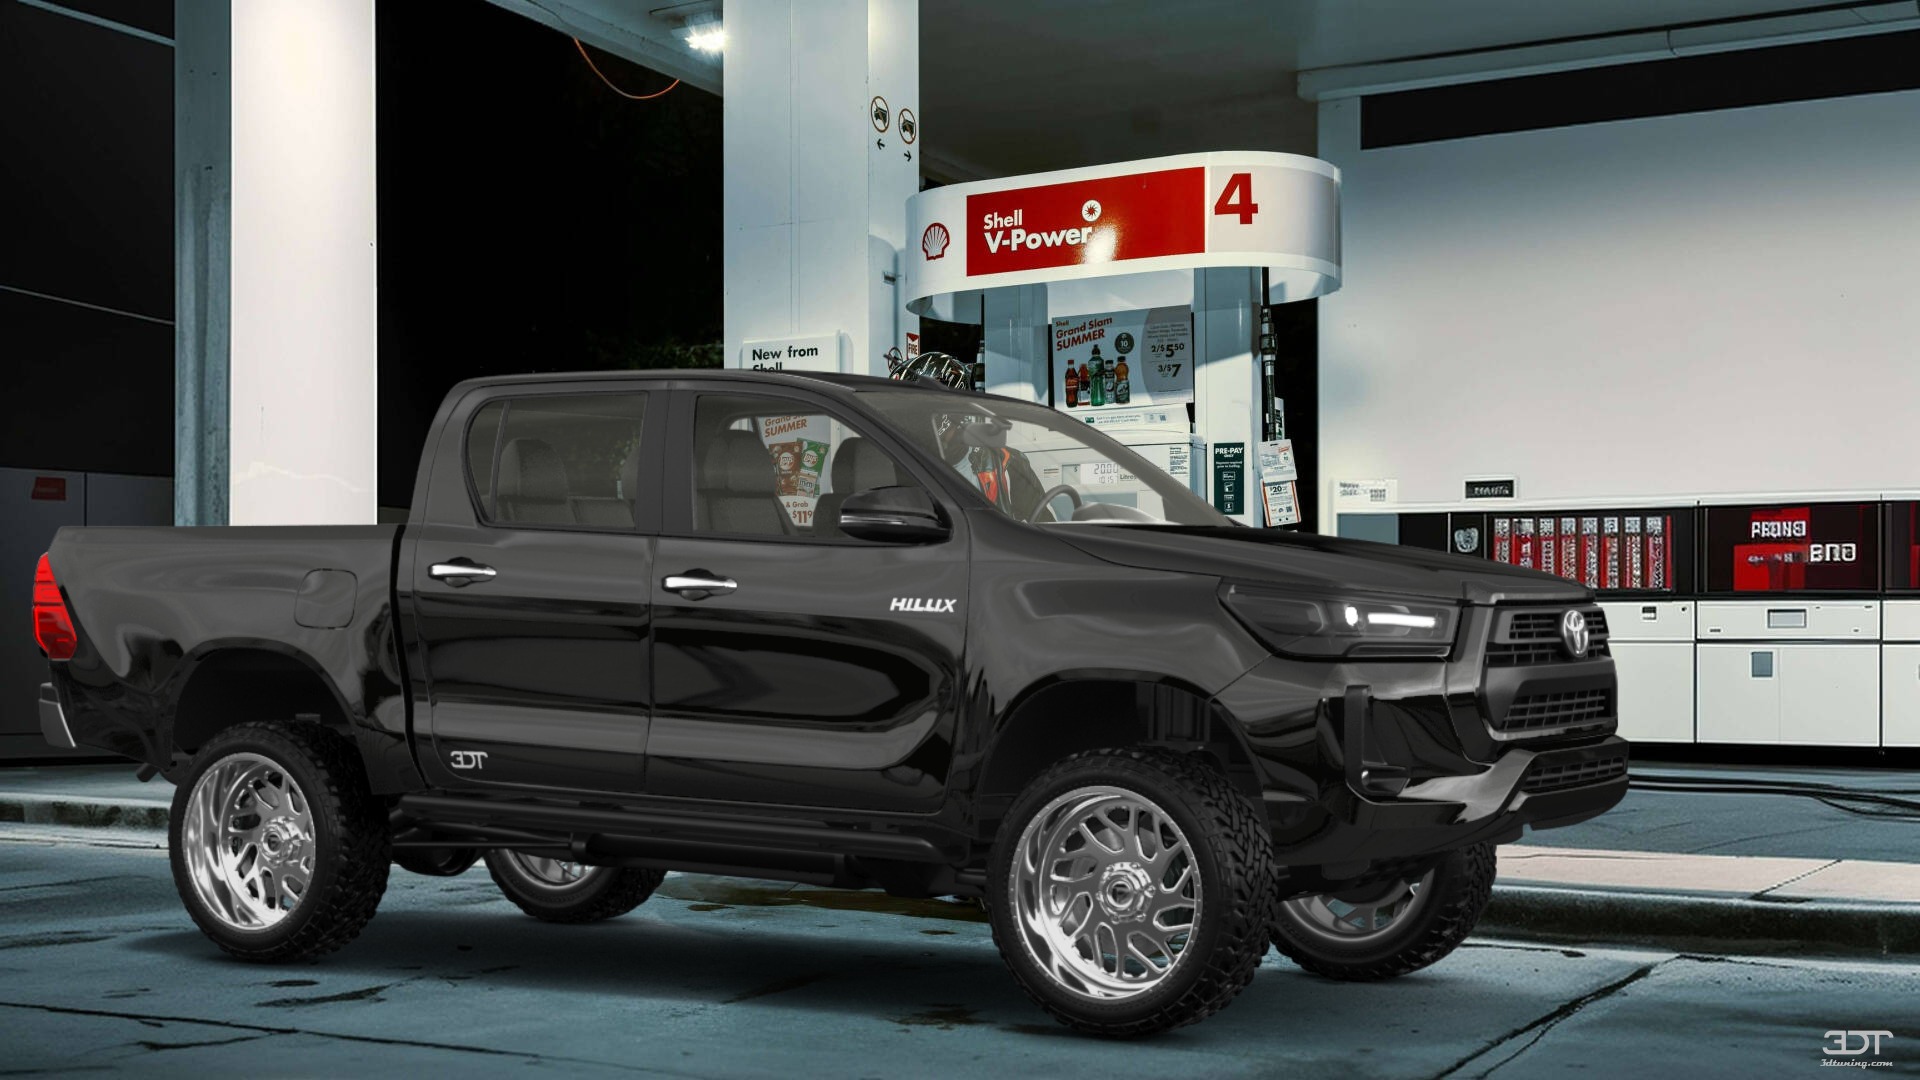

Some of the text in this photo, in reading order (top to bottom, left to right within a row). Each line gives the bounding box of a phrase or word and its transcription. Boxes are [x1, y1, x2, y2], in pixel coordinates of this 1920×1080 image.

[1214, 173, 1259, 225] 4
[983, 208, 1023, 230] Shell
[984, 226, 1093, 254] V-Power
[1056, 317, 1112, 339] Grand Slam
[1056, 329, 1105, 351] SUMMER
[752, 346, 818, 361] New from
[765, 419, 807, 437] SUMMER
[889, 597, 958, 613] HILUX
[450, 750, 489, 769] 3DT
